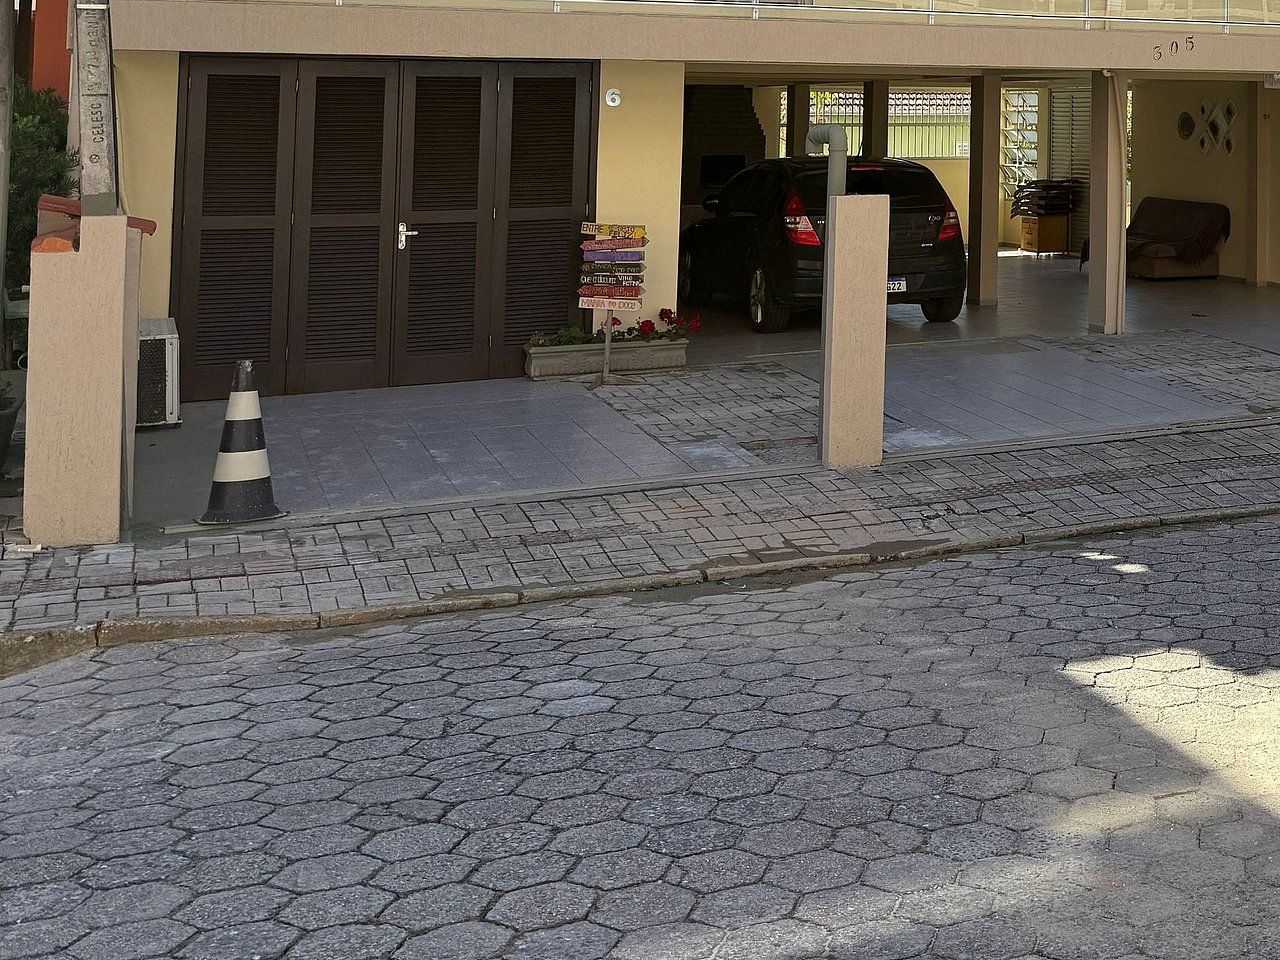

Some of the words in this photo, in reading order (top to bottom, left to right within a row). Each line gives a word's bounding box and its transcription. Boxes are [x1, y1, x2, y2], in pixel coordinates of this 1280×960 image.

[1152, 35, 1195, 61] 305
[605, 88, 621, 107] 6
[90, 102, 105, 144] CELESC
[583, 224, 604, 233] ENTRE
